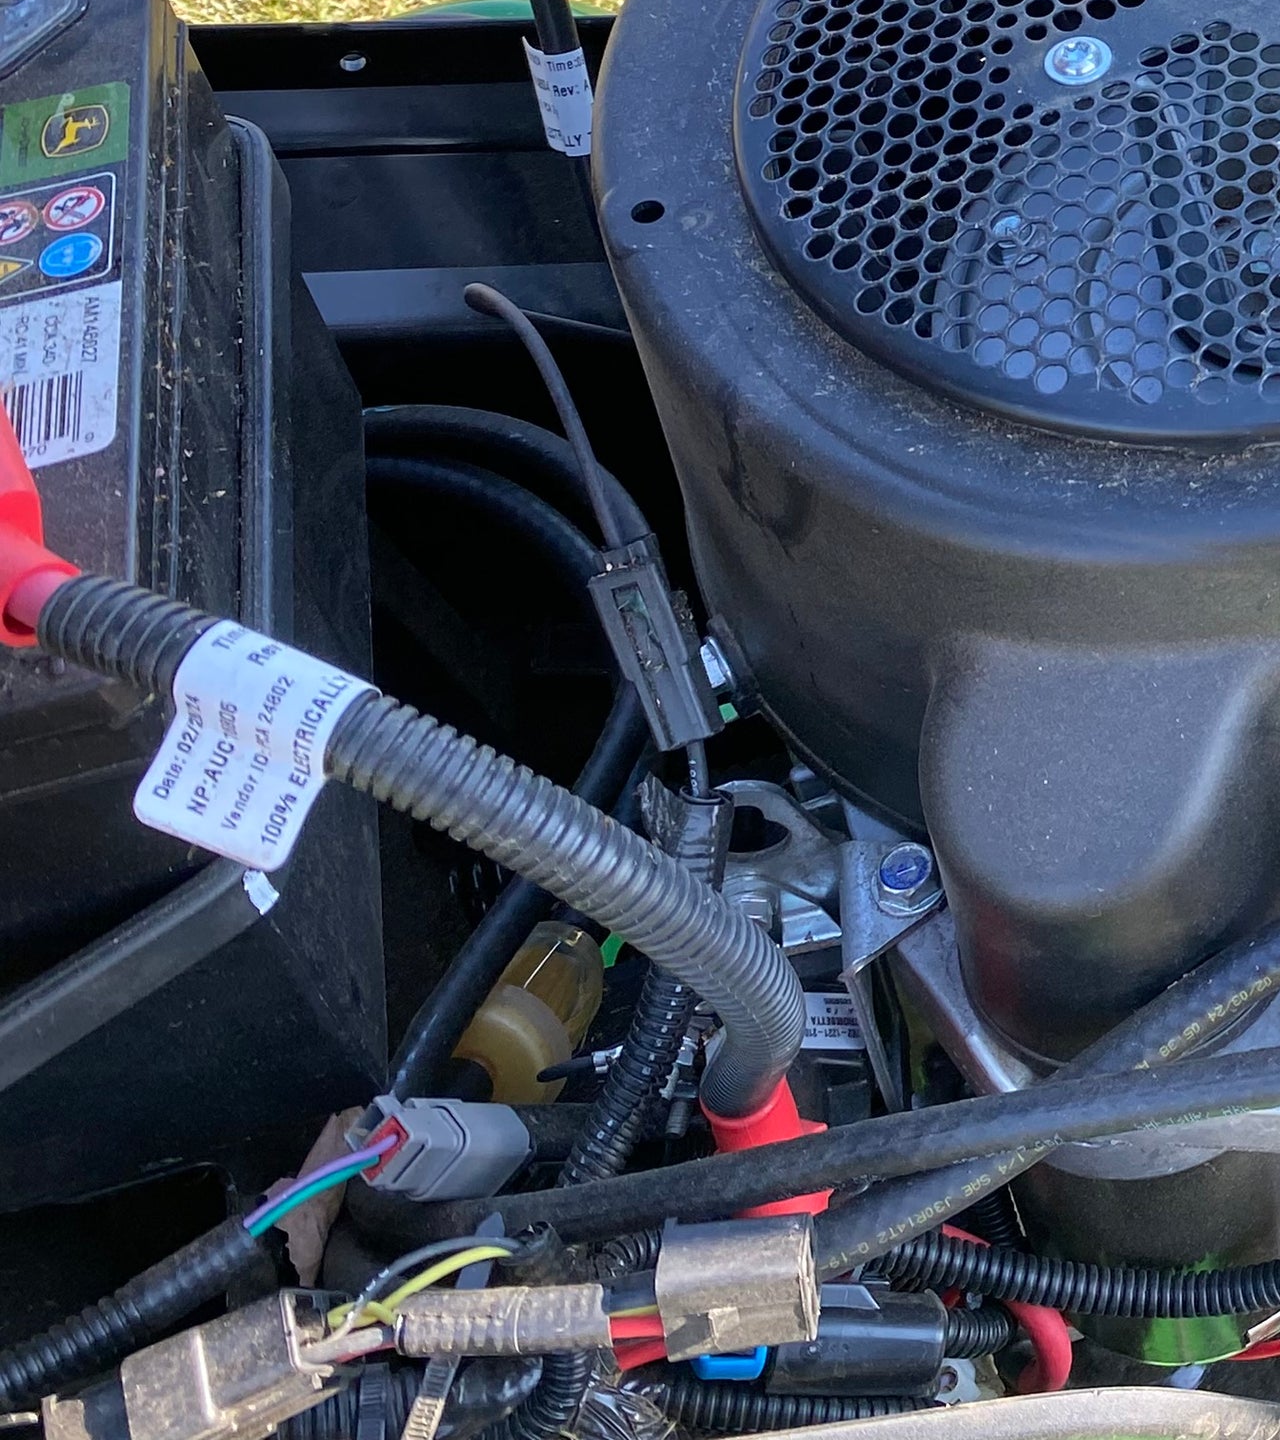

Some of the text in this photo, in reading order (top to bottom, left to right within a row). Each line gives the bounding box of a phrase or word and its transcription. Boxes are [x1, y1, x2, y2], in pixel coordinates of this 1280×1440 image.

[220, 773, 260, 832] Vendor
[257, 673, 296, 727] 24802
[261, 673, 354, 846] 100% ELECTRICALLY
[153, 756, 188, 801] Date:
[961, 1173, 992, 1198] SAE
[876, 1195, 953, 1245] J30R14T2
